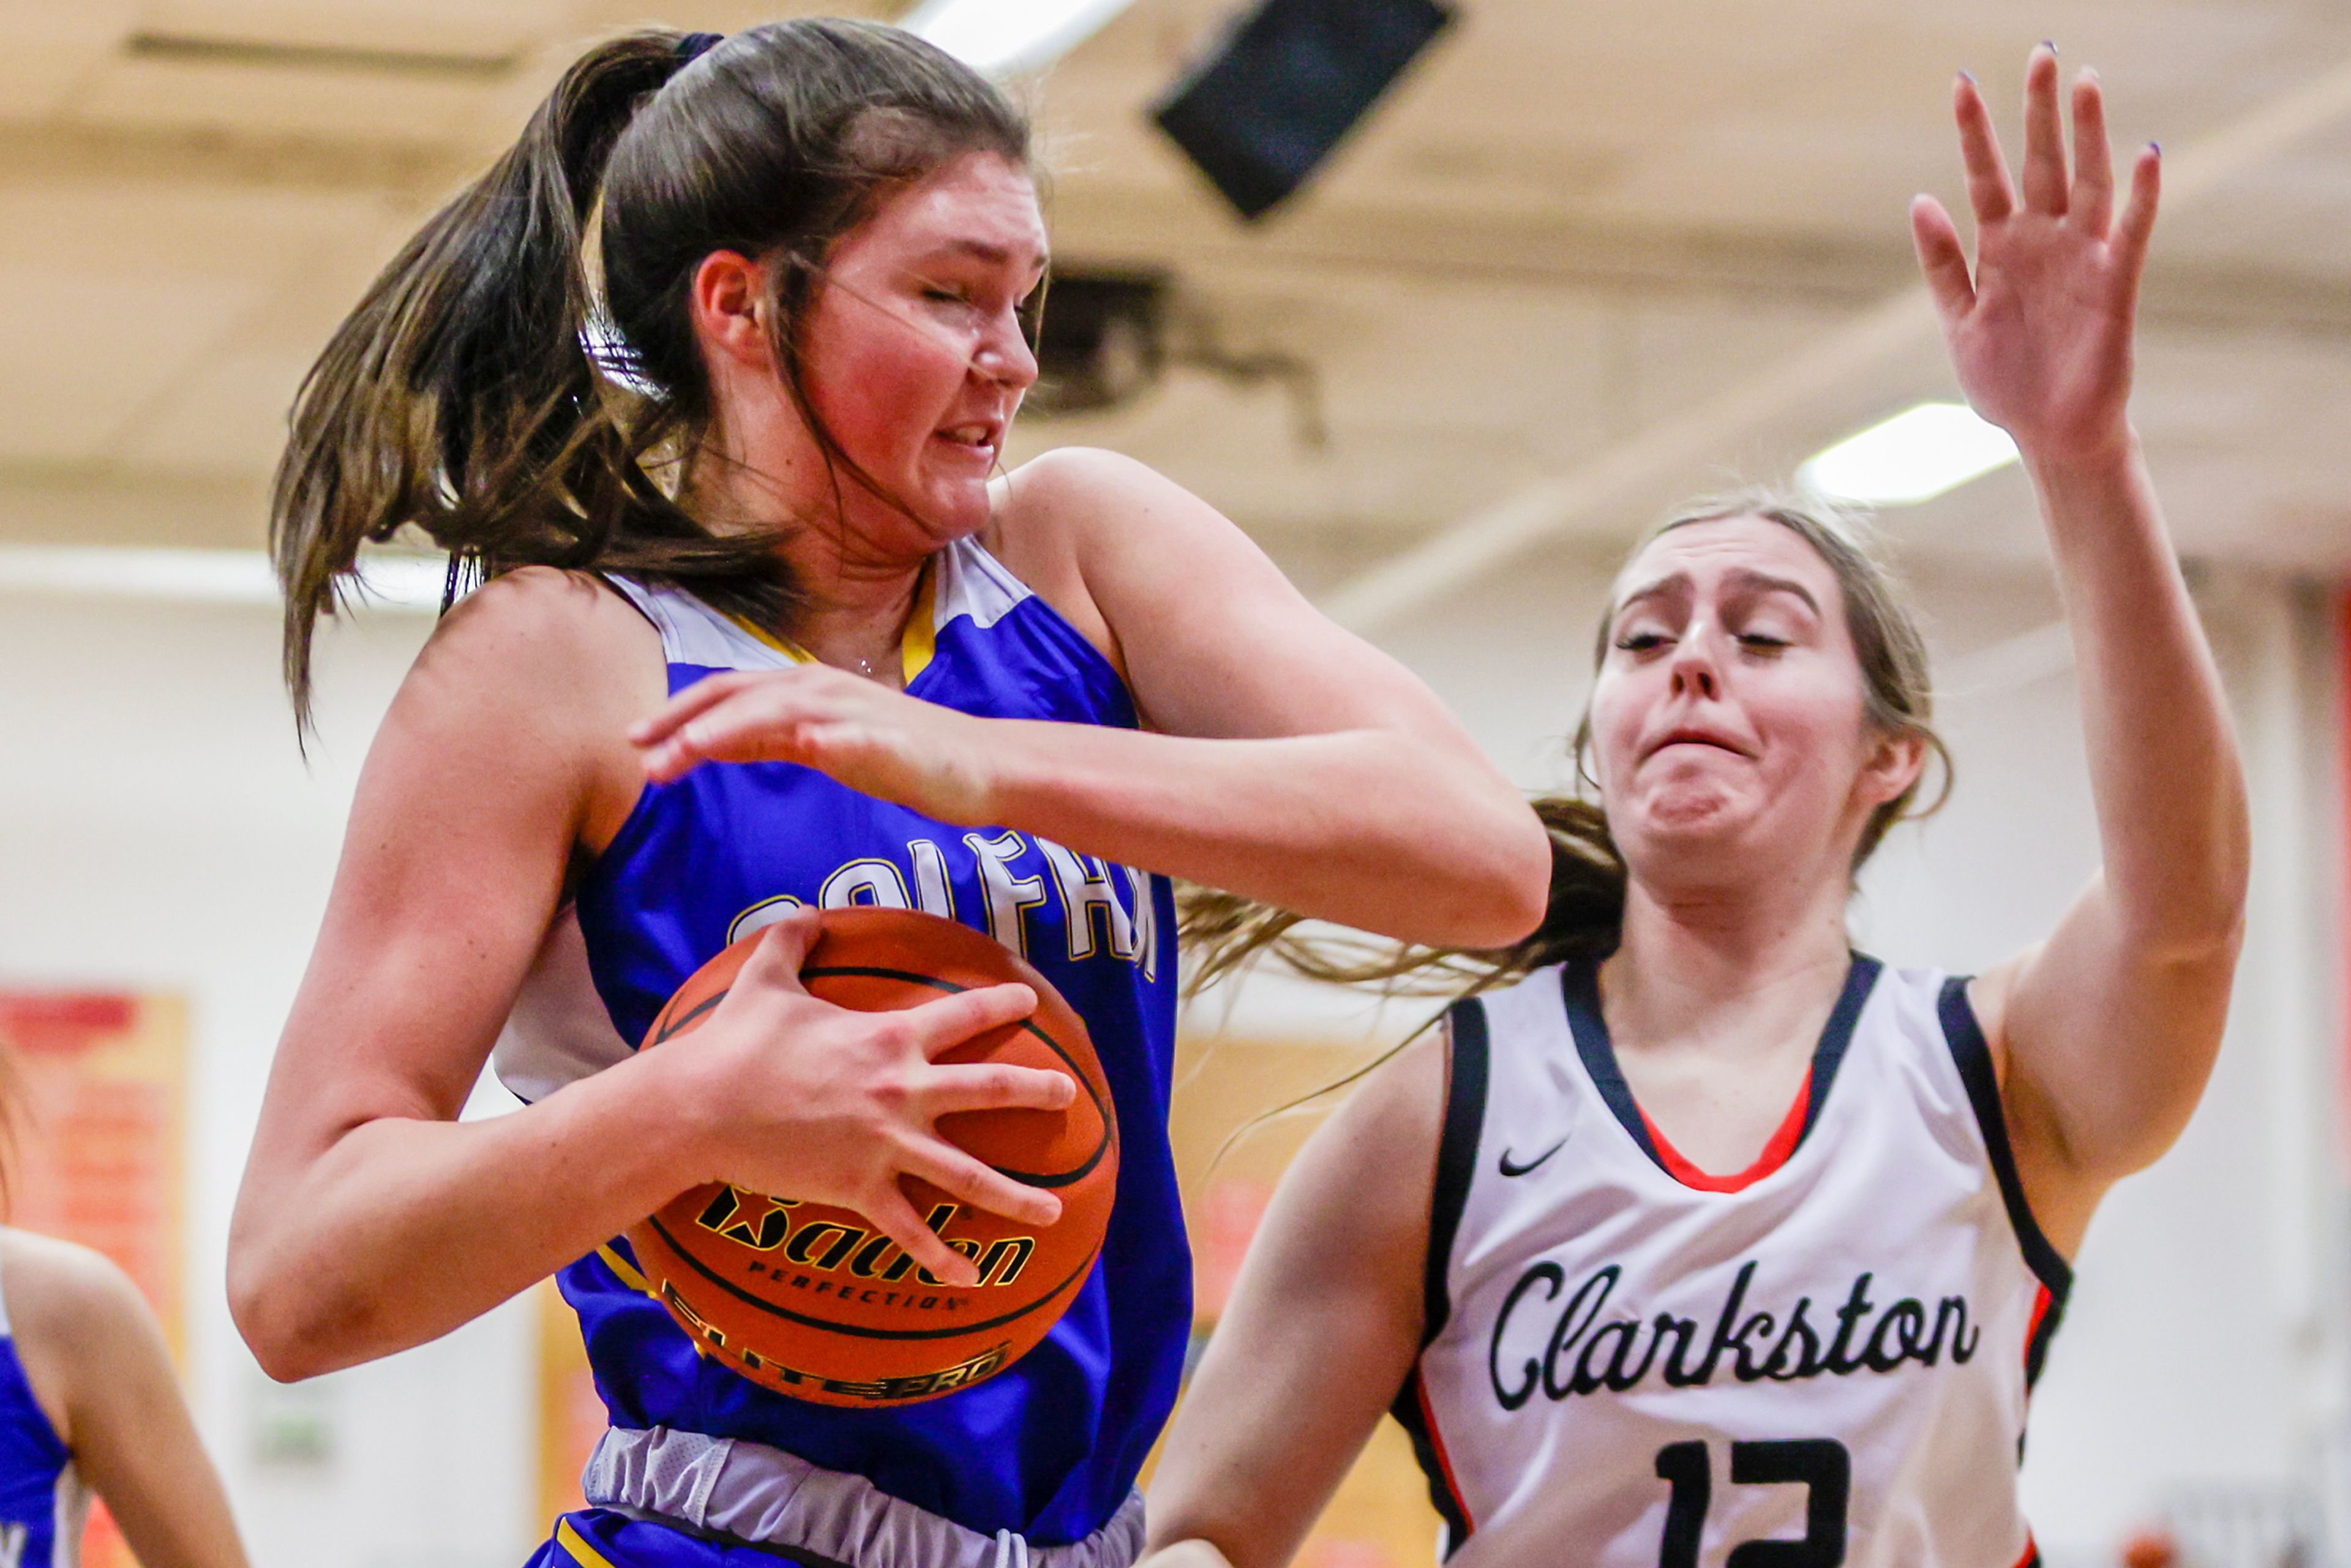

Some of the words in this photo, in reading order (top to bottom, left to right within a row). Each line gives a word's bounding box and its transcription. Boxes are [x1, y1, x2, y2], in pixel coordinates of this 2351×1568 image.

[748, 1259, 958, 1311] PERFECTION
[1490, 1260, 1979, 1411] Clarkston
[1655, 1438, 1851, 1568] 12
